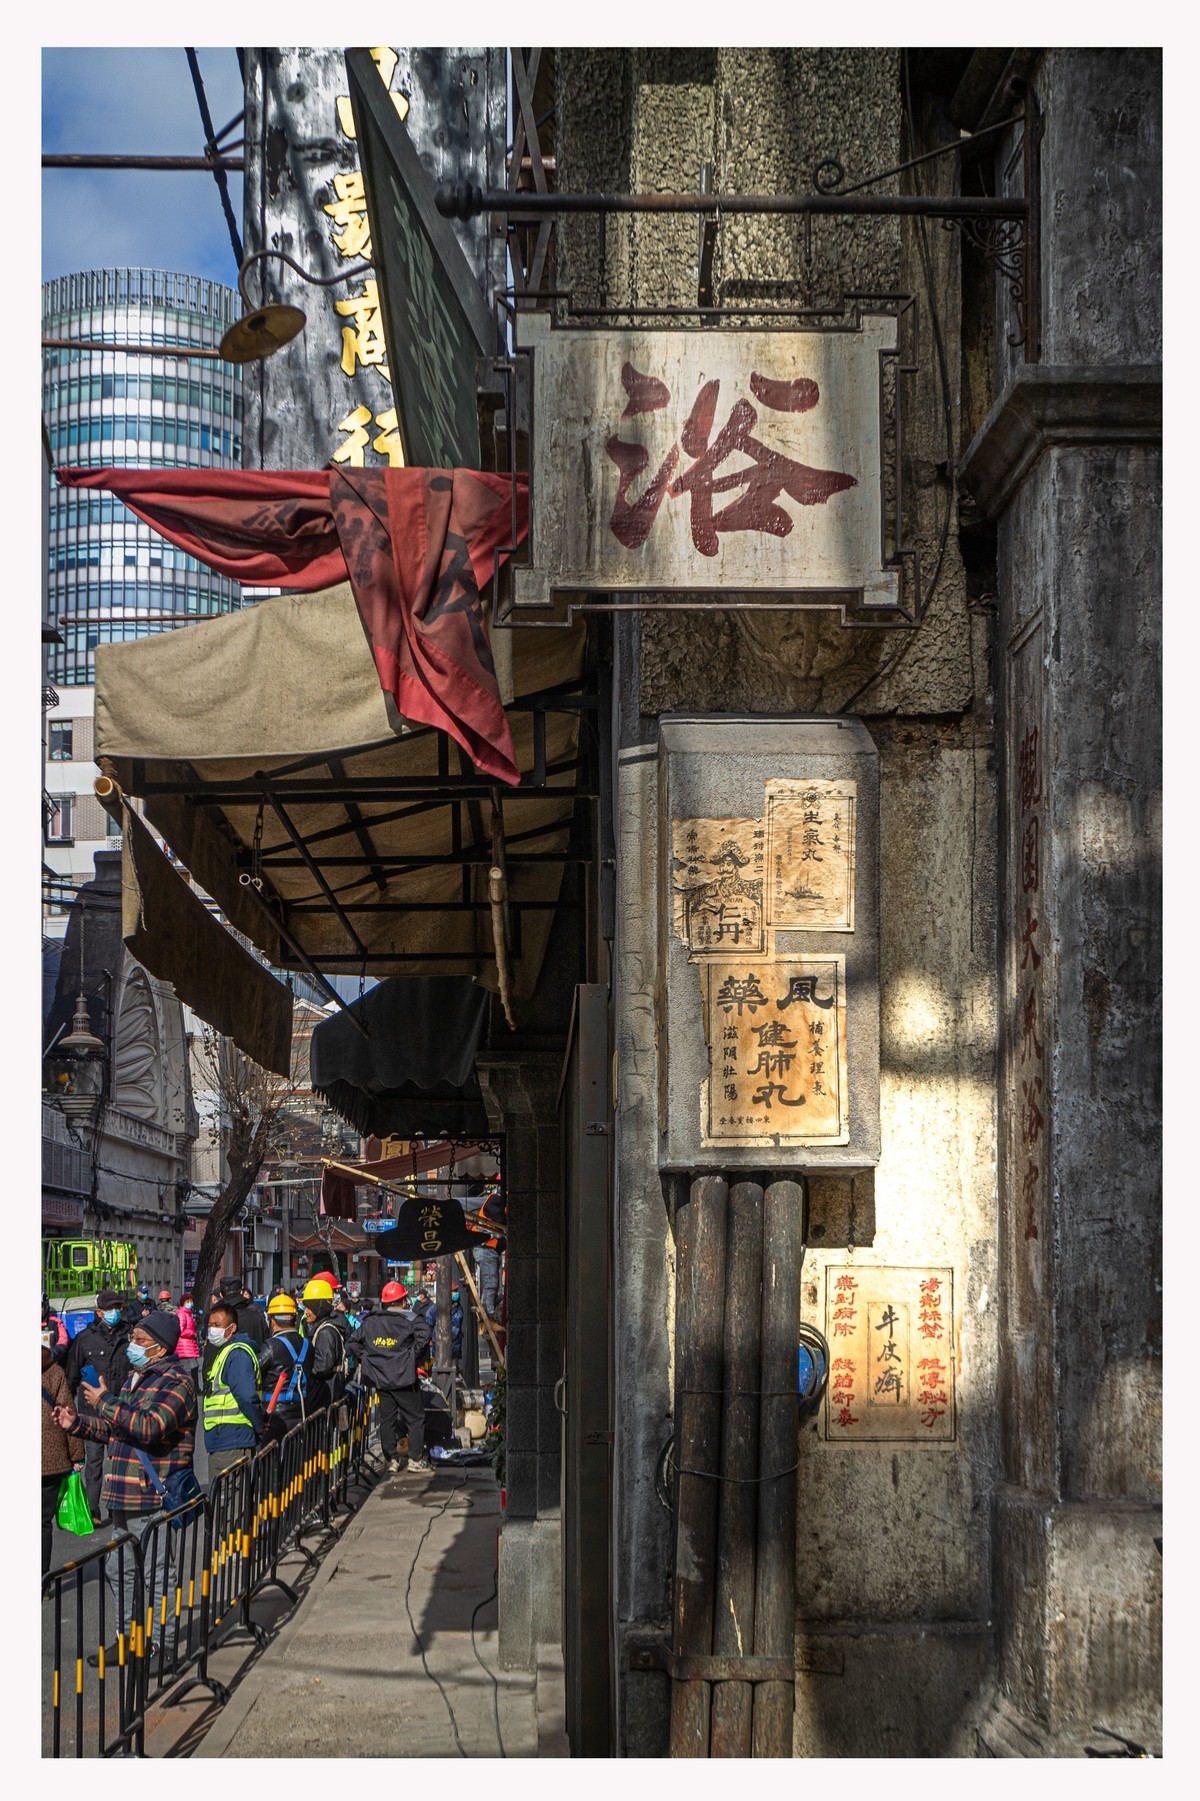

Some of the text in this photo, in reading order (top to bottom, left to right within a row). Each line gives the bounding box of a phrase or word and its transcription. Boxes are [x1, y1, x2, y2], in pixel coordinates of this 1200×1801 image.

[605, 361, 858, 557] 浴
[713, 903, 744, 944] 仁丹
[747, 1020, 806, 1109] 健肺丸
[418, 1205, 443, 1252] 榮昌
